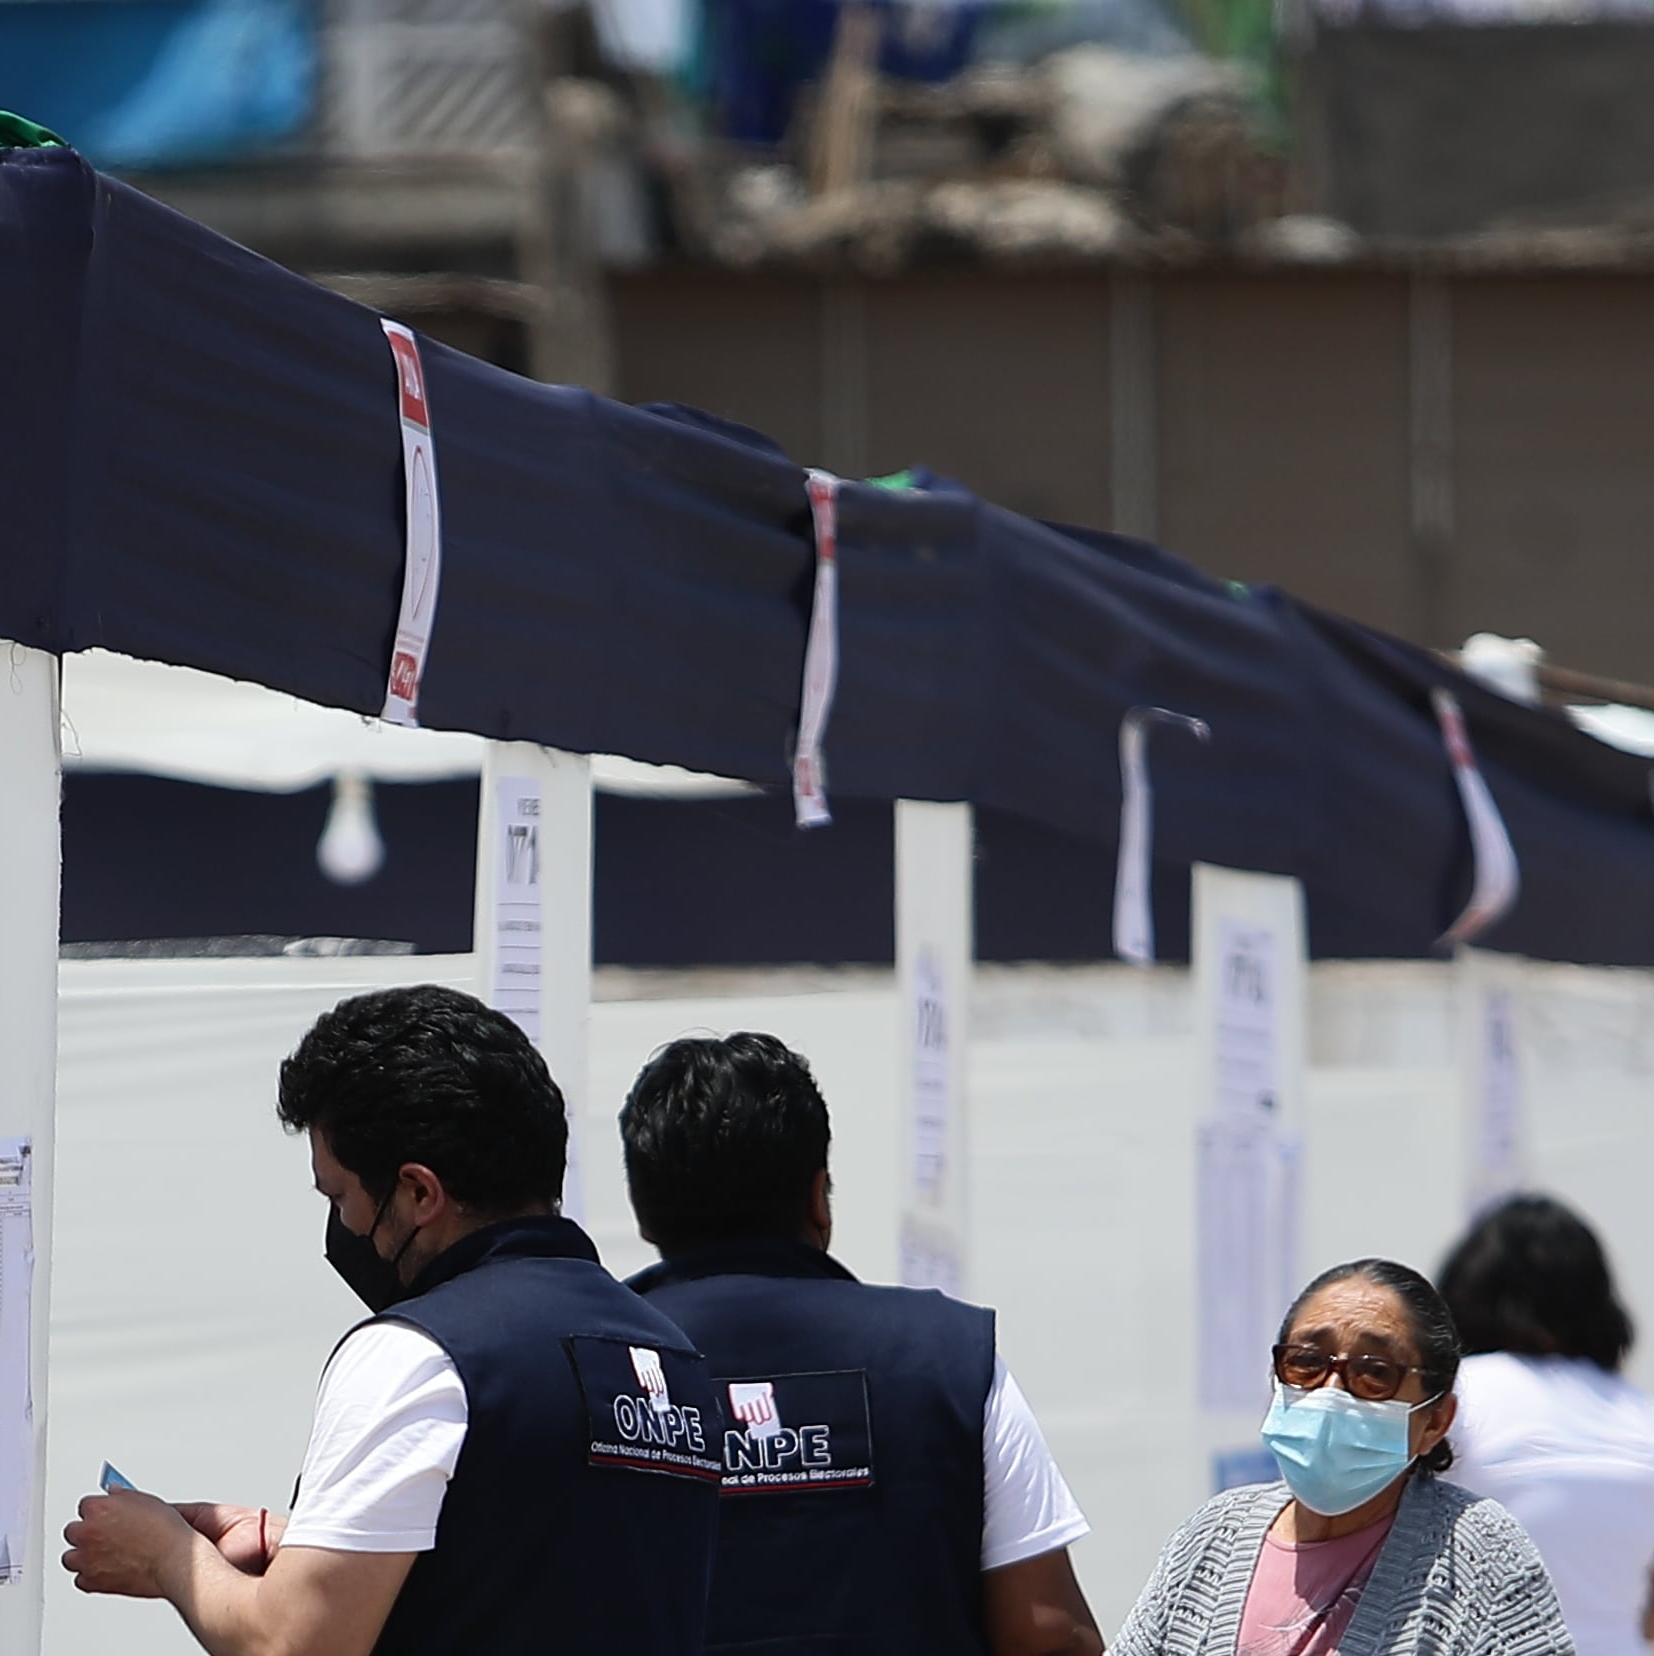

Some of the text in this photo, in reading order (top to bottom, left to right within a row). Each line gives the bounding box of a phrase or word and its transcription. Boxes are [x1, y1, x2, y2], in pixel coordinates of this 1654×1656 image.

[614, 1395, 705, 1452] ONPE
[619, 1444, 650, 1458] Nacional
[651, 1450, 661, 1460] de
[662, 1450, 692, 1464] Procesos
[725, 1425, 831, 1470] NPE
[741, 1474, 755, 1484] de
[757, 1471, 807, 1482] Procesos
[809, 1467, 869, 1480] Electorales
